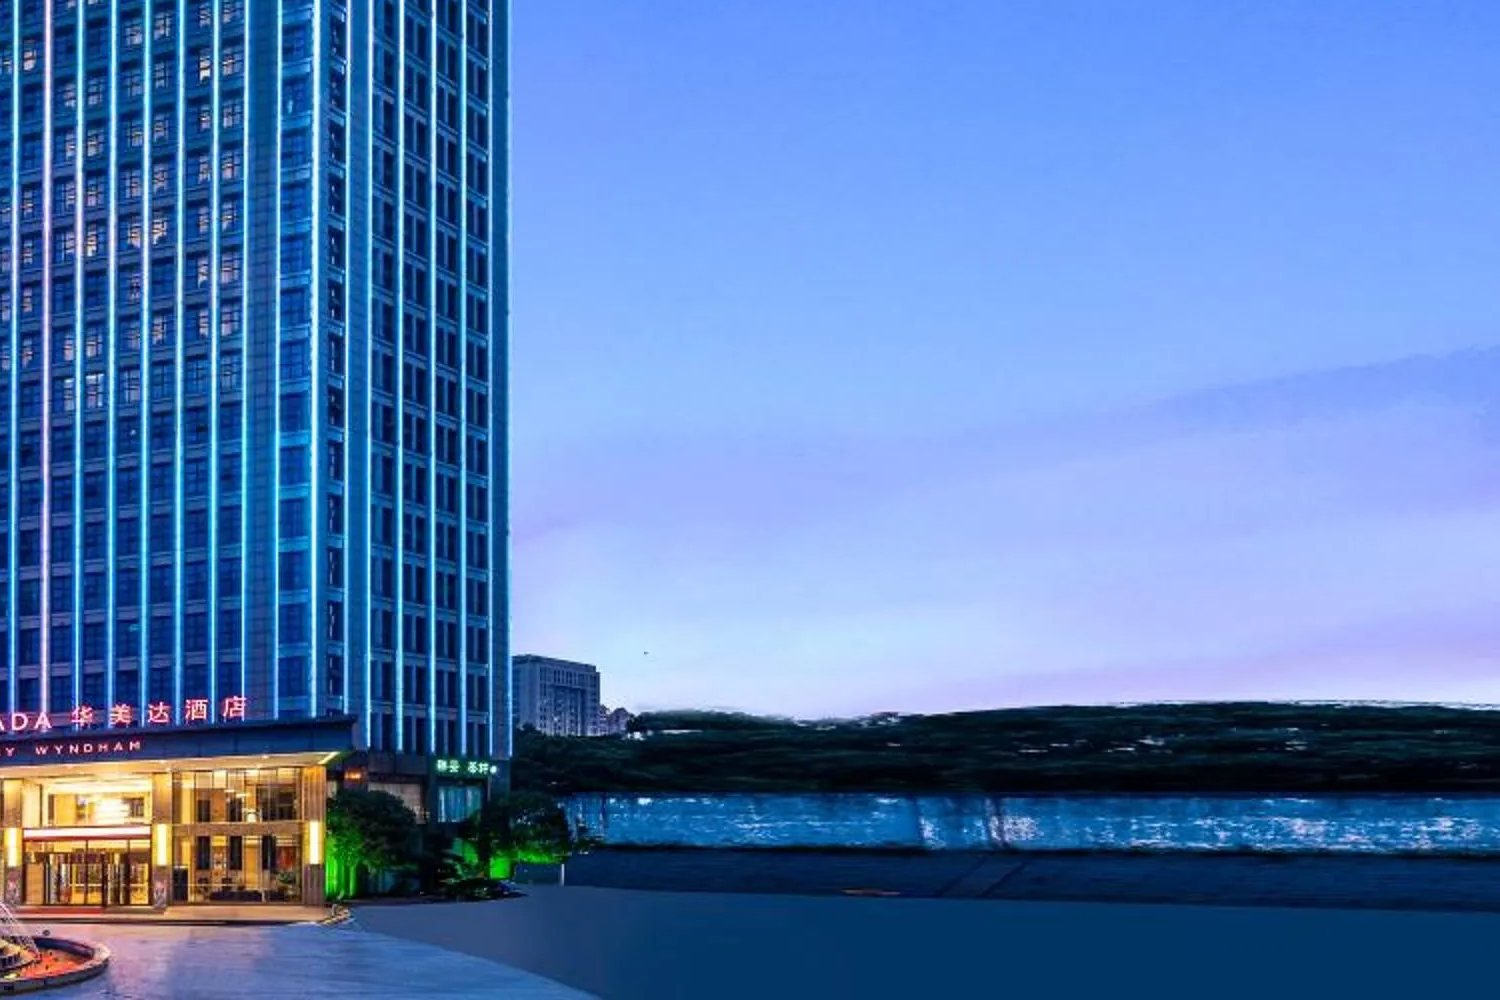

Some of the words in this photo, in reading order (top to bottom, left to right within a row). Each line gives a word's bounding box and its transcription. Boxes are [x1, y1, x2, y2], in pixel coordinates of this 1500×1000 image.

[71, 695, 248, 727] 华美达酒店
[35, 740, 142, 756] WYNDHAM
